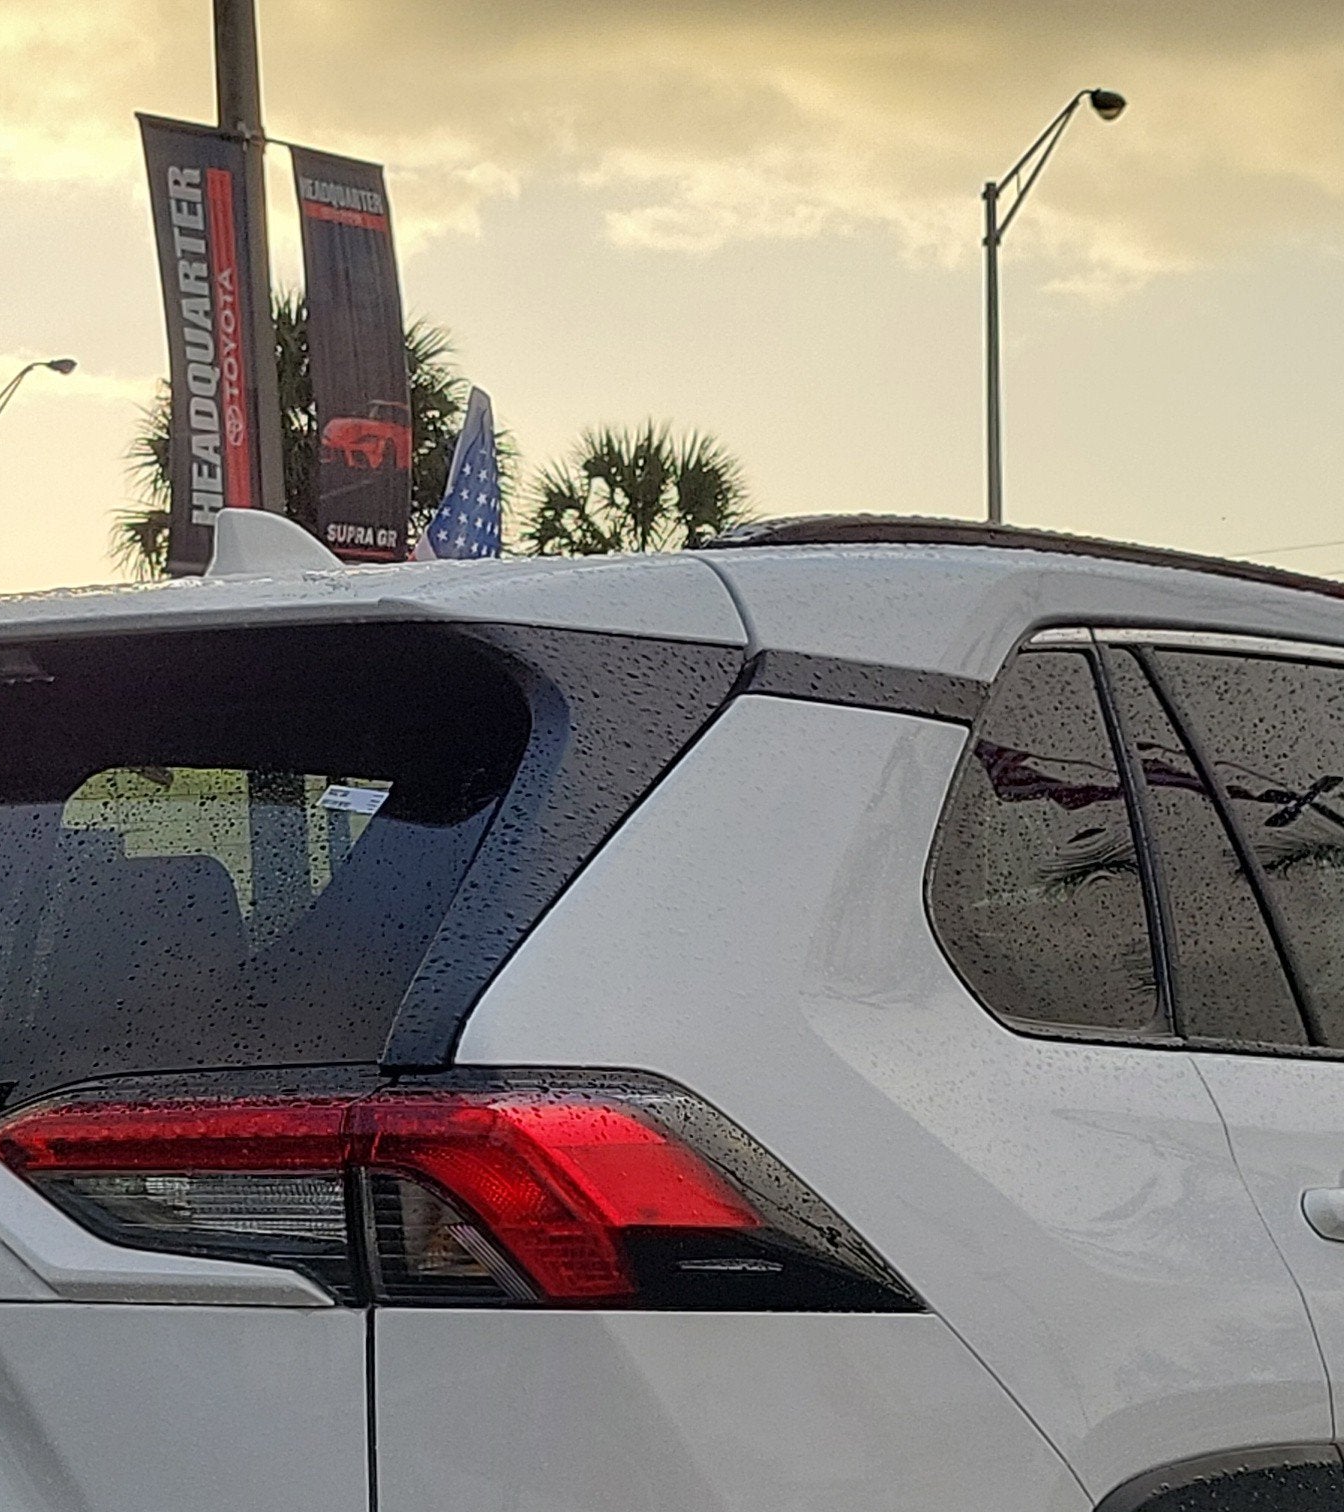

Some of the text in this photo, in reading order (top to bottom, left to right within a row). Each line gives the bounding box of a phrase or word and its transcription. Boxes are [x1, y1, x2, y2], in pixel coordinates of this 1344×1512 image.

[167, 165, 224, 525] HEADQUARTER
[217, 267, 239, 399] TOYOTA
[326, 523, 398, 548] SUPRA GR
